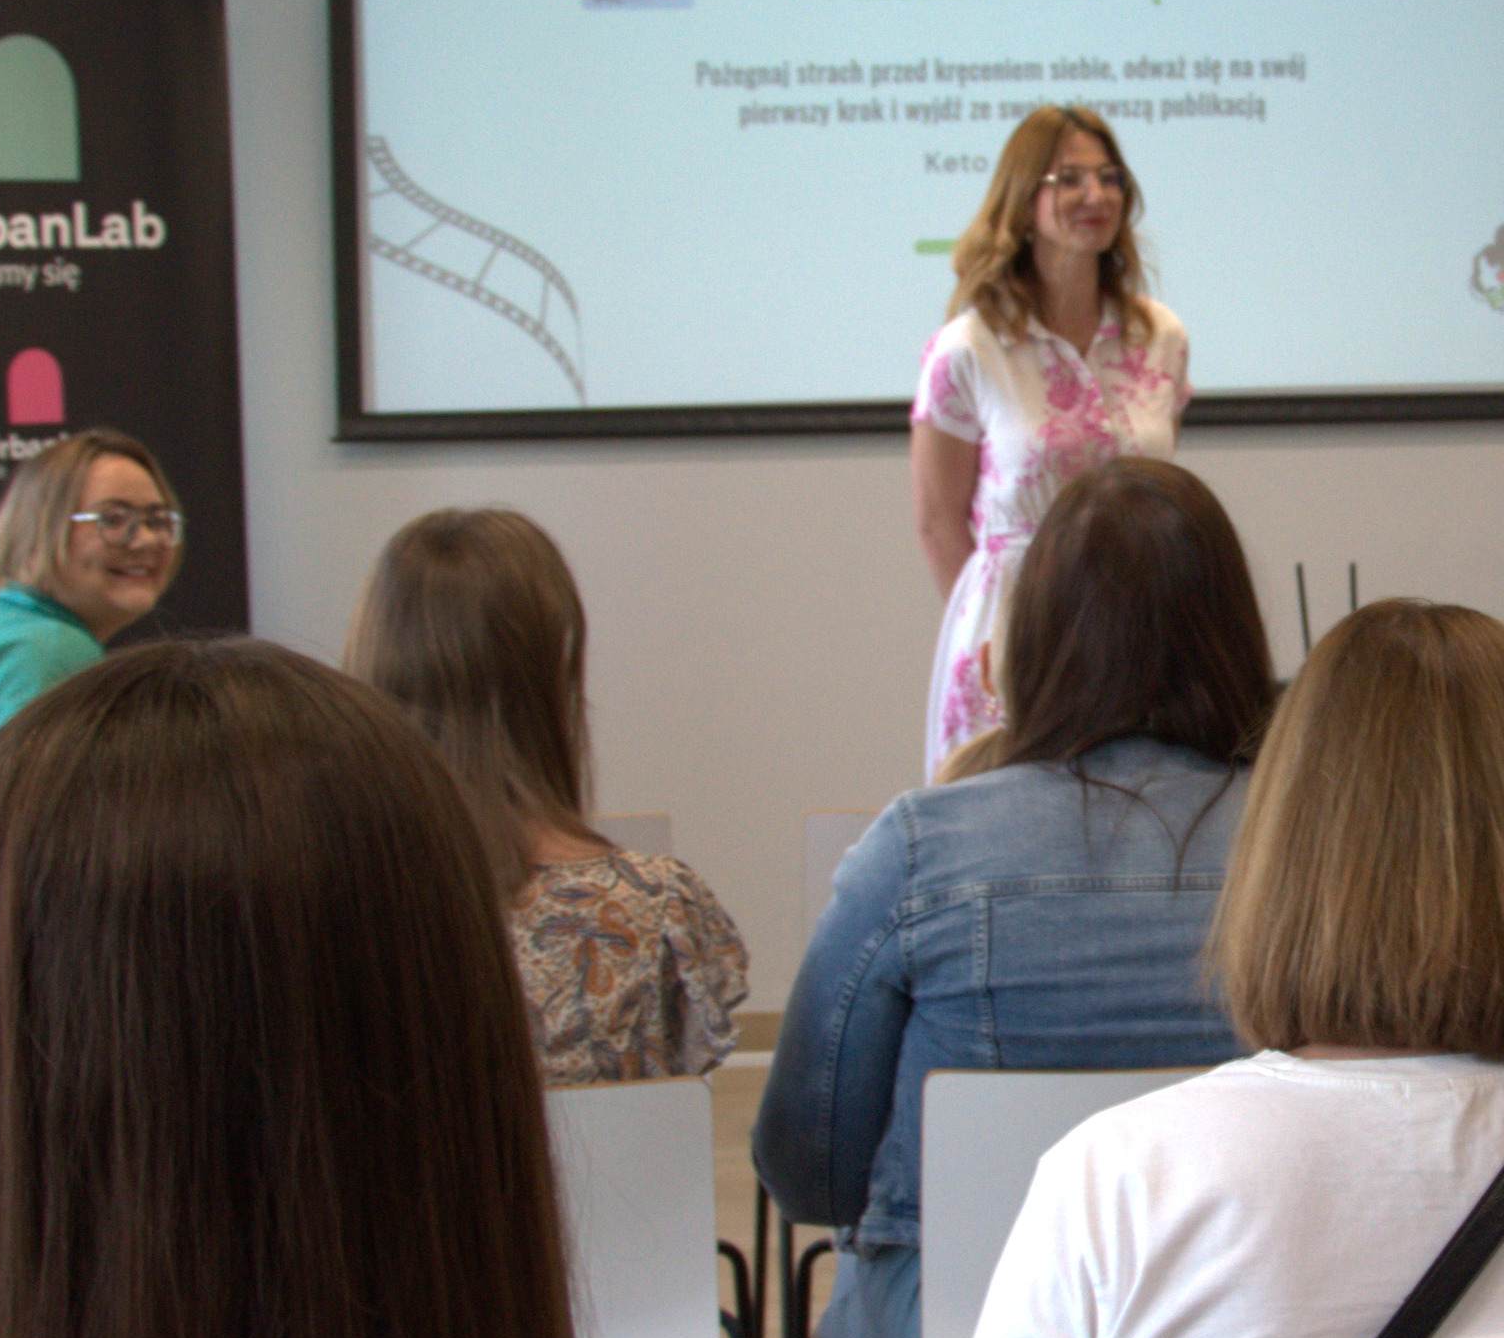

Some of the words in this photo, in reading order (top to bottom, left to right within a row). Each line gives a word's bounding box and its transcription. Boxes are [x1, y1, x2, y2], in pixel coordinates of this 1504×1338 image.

[696, 60, 789, 90] Pożegnaj
[797, 59, 864, 85] strach
[870, 59, 928, 88] przed
[934, 58, 1043, 88] kręceniem
[1050, 56, 1116, 83] siebie,
[1194, 56, 1223, 85] się
[1229, 60, 1254, 79] na
[1260, 54, 1306, 82] swój
[739, 101, 830, 129] pierwszy
[837, 97, 884, 123] krok
[970, 102, 992, 121] ze
[1159, 92, 1266, 122] publikacją
[42, 257, 81, 292] się
